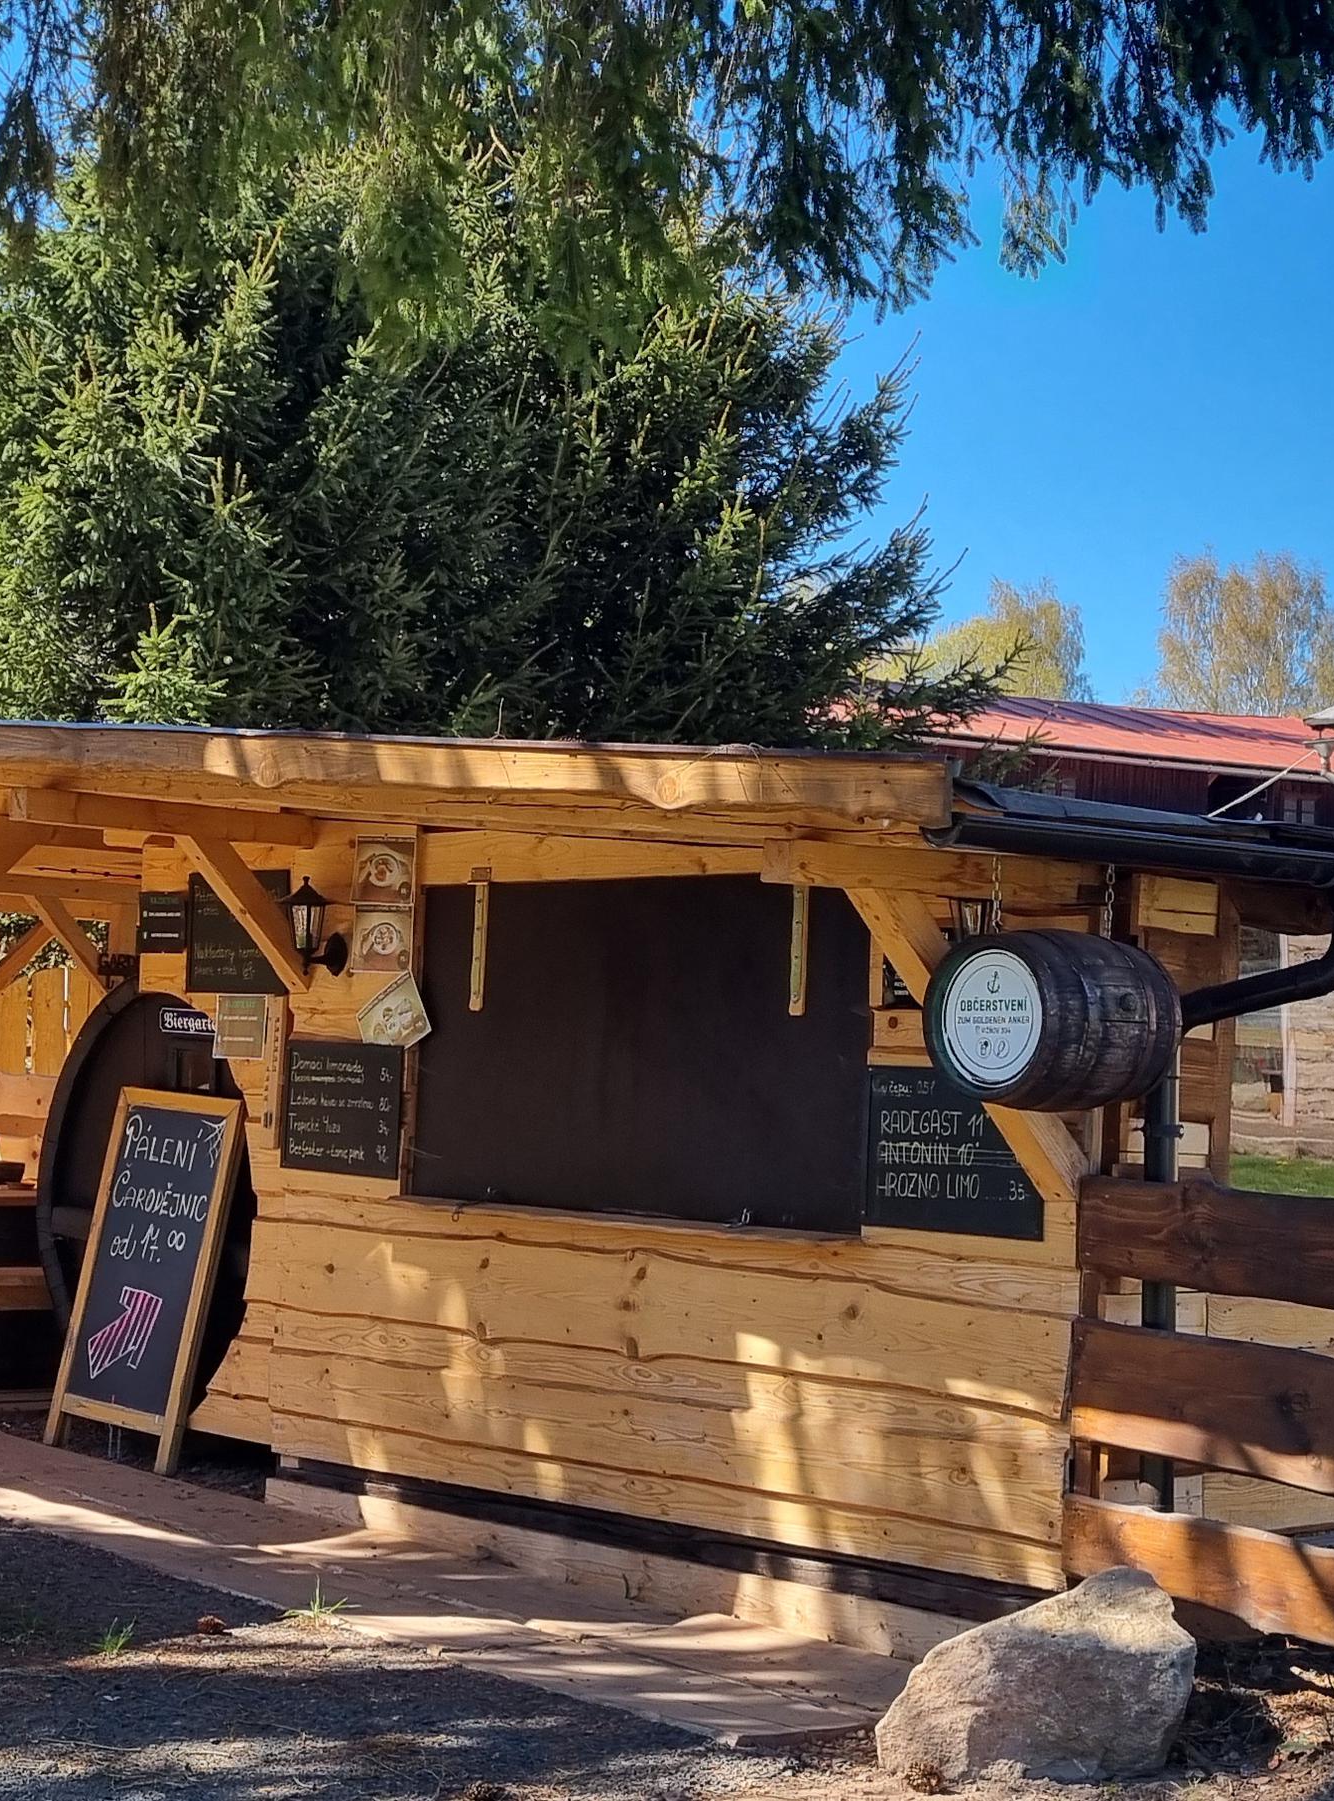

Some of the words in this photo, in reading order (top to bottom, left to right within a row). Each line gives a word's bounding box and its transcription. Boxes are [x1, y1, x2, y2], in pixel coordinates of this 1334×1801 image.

[960, 995, 1028, 1012] OBČERSTVENÍ
[163, 1011, 217, 1032] Biergarte
[1008, 1015, 1030, 1025] ANKER
[880, 1109, 963, 1136] RADEGAST
[123, 1114, 204, 1172] PÁLENÍ
[112, 1162, 208, 1222] ČARODĚJNIC
[875, 1171, 940, 1199] HROZNO
[946, 1173, 980, 1199] LIMO
[110, 1223, 137, 1260] od
